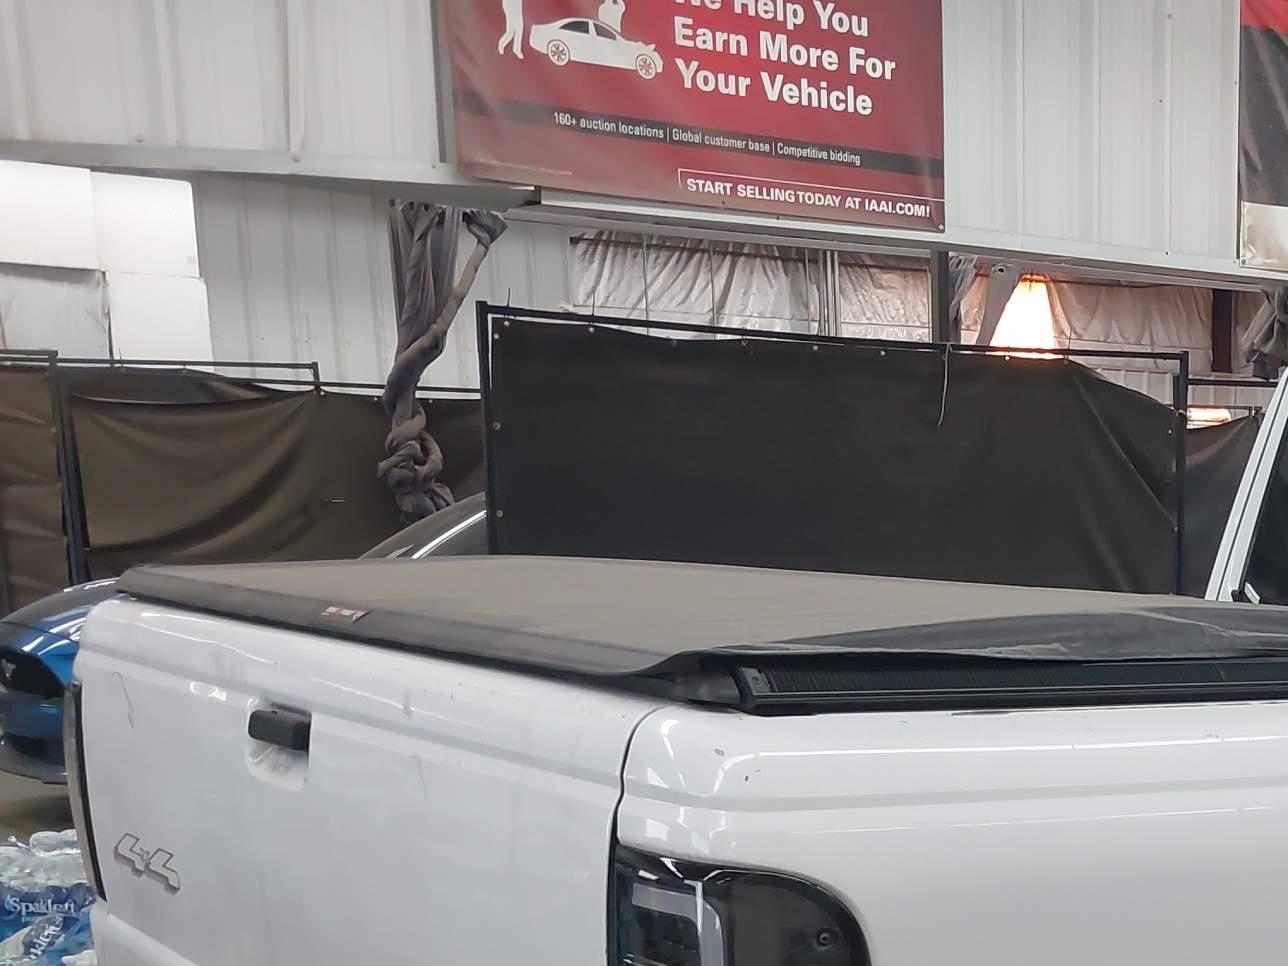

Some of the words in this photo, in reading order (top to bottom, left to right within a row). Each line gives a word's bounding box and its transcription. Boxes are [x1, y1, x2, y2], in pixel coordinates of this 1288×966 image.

[813, 0, 869, 37] You
[674, 16, 748, 56] Earn
[759, 30, 839, 71] More
[849, 46, 896, 80] For
[675, 58, 751, 97] Your
[760, 71, 873, 115] Vehicle
[553, 111, 577, 126] 160+
[579, 117, 617, 133] auction
[618, 120, 664, 139] locations
[672, 128, 702, 144] Global
[704, 134, 746, 149] customer
[748, 138, 770, 153] base
[777, 142, 829, 160] Competitive
[829, 149, 861, 167] bidding
[686, 178, 733, 196] START
[737, 184, 796, 203] SELLING
[796, 190, 841, 208] TODAY
[844, 197, 863, 210] AT
[864, 200, 931, 218] IAAI.COM!
